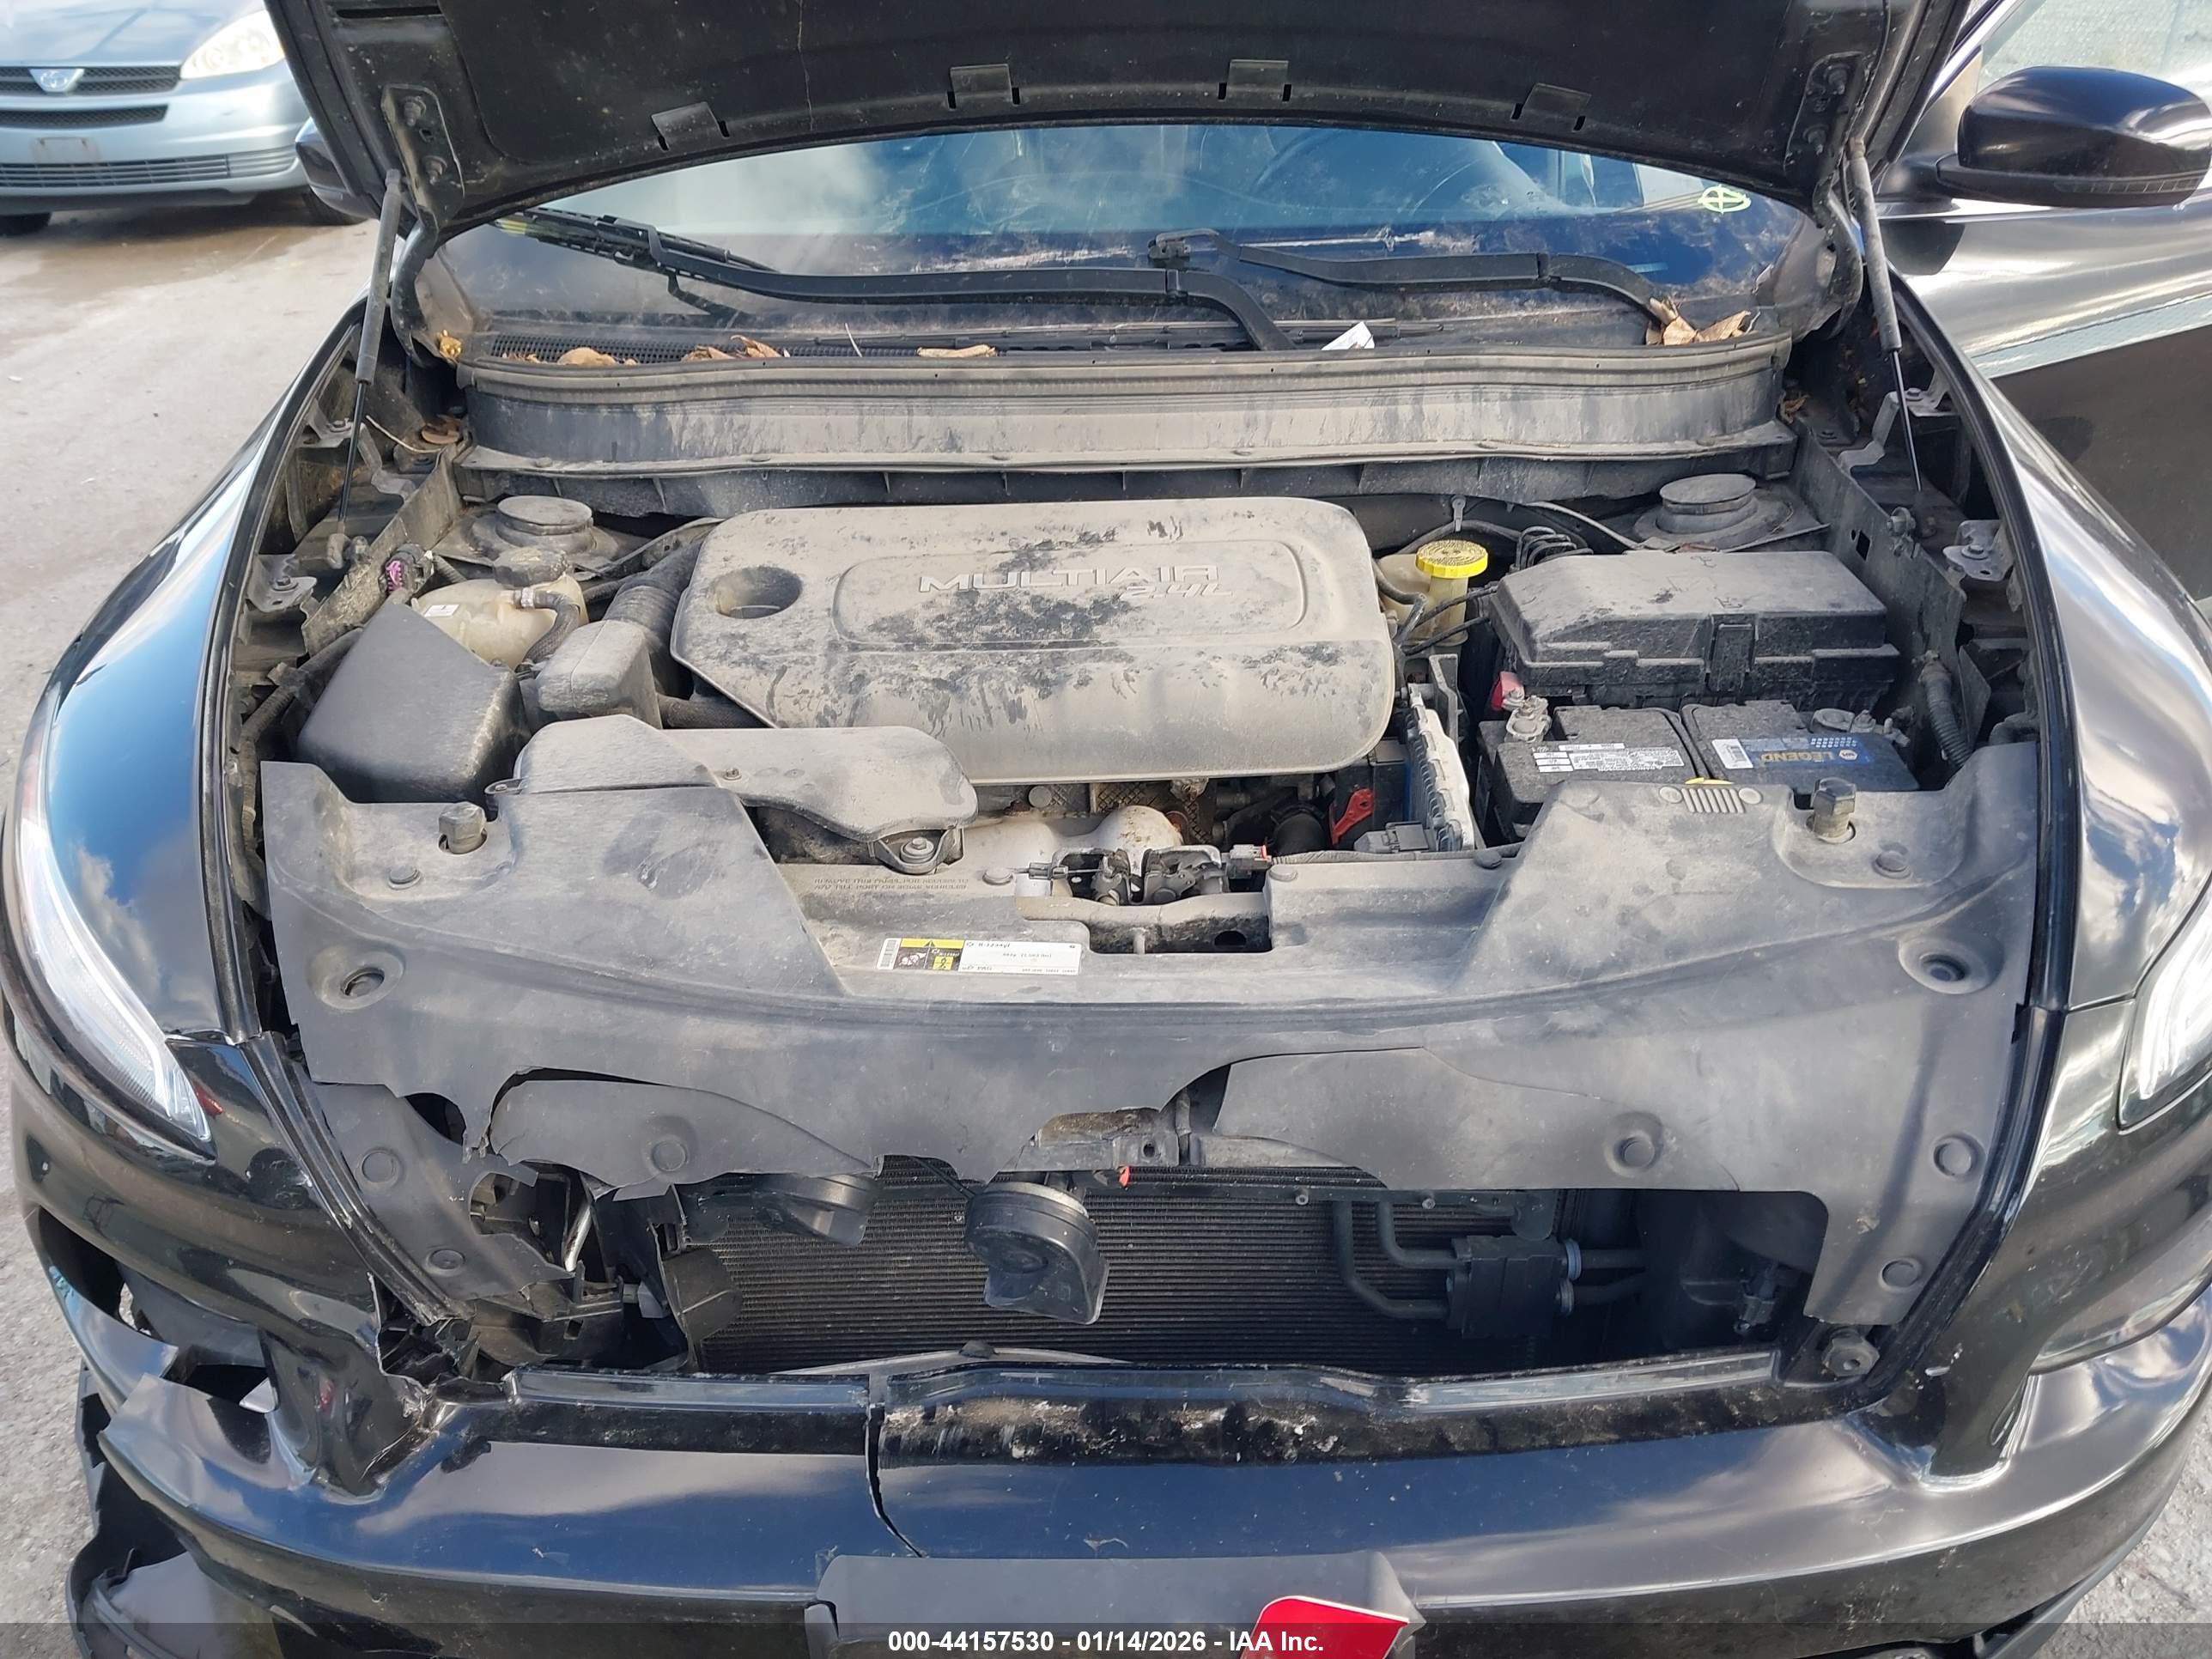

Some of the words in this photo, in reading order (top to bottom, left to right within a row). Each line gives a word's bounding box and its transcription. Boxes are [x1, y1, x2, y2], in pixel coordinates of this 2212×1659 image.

[919, 565, 1219, 592] MULTIAIR
[1119, 583, 1233, 601] 2.4L
[1760, 750, 1835, 763] LEGEND
